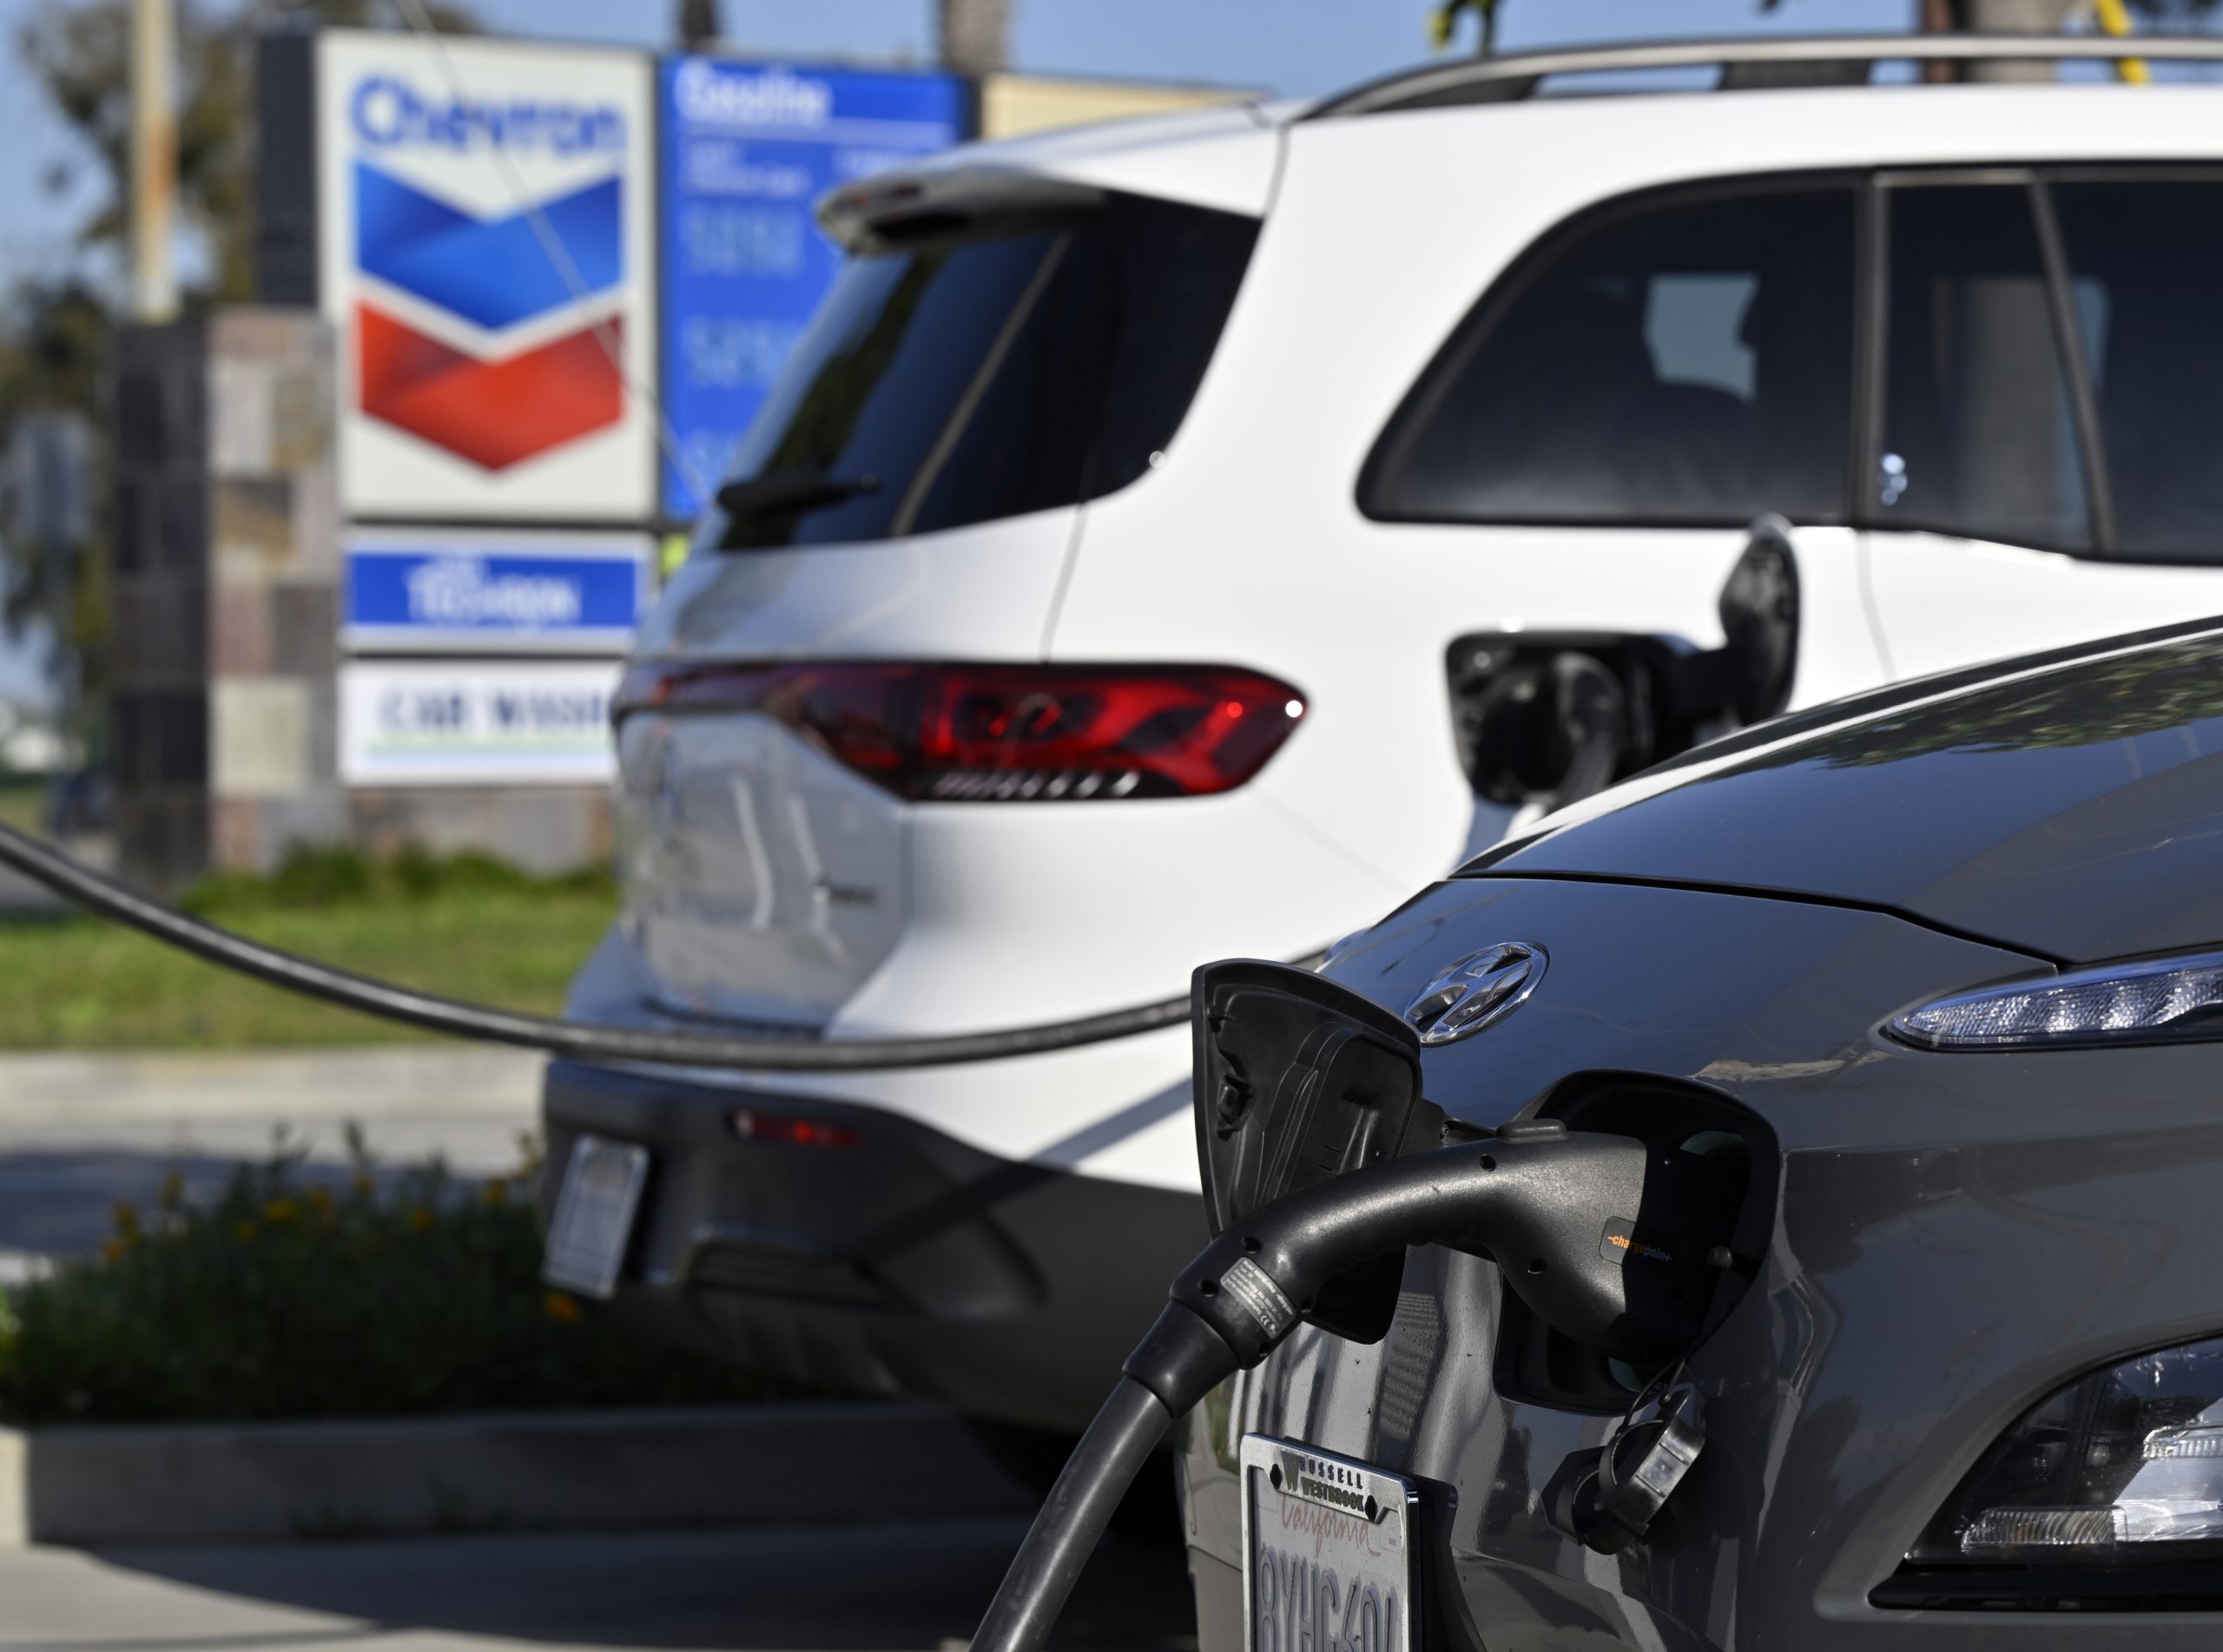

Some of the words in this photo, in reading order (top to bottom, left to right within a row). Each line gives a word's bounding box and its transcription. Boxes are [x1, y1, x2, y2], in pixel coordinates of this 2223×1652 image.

[347, 71, 625, 160] Chevron
[1299, 1457, 1363, 1491] RUSSELL
[1301, 1477, 1365, 1512] WESTBROOK
